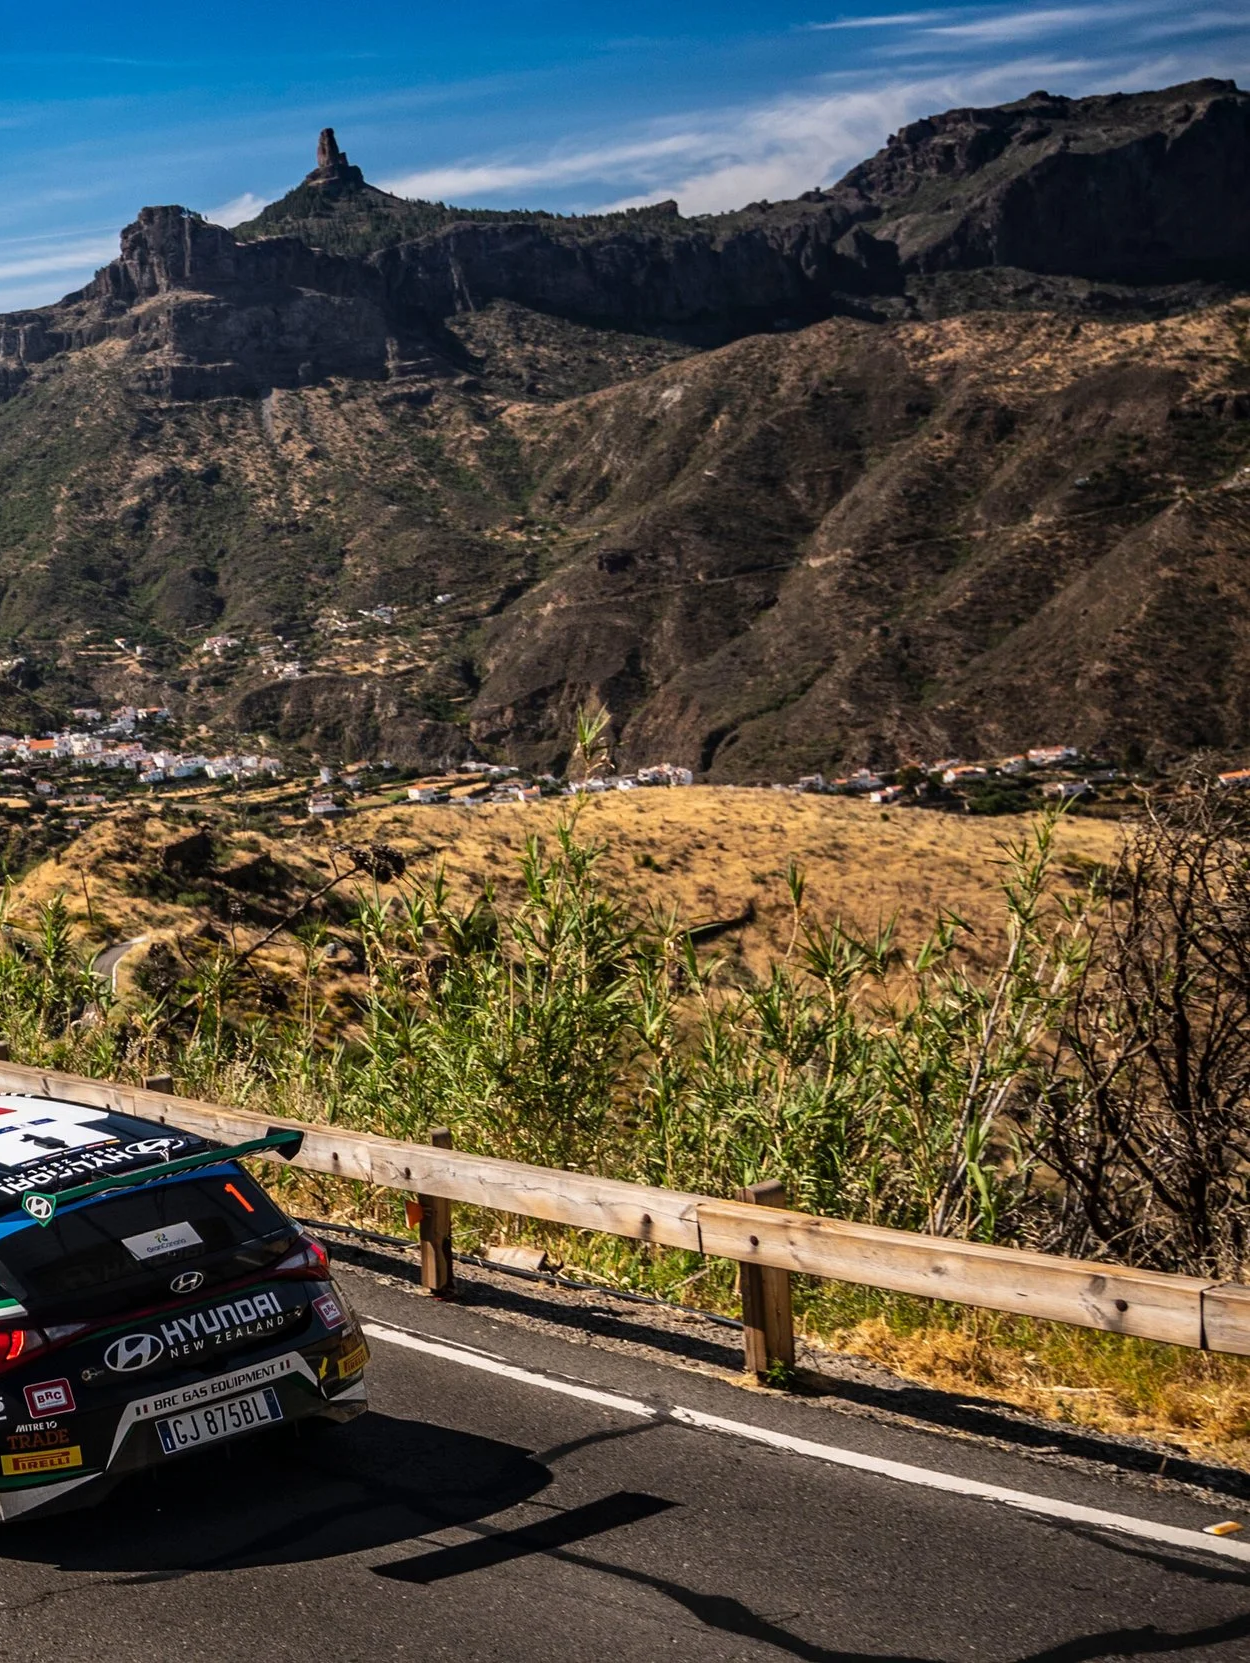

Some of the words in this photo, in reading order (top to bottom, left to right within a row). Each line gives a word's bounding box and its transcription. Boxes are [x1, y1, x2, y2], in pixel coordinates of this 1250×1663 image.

[80, 1147, 117, 1159] NEW
[224, 1182, 255, 1212] 1
[160, 1291, 283, 1346] HYUNDAI
[170, 1340, 205, 1358] NEW
[214, 1315, 284, 1344] ZEALAND
[37, 1390, 62, 1404] BRC
[154, 1394, 179, 1411] BRC
[182, 1386, 208, 1403] GAS
[211, 1364, 276, 1395] EQUIPMENT
[15, 1421, 44, 1433] MITRE
[45, 1420, 58, 1430] 10
[172, 1415, 200, 1445] GJ
[7, 1429, 70, 1450] TRADE
[12, 1451, 71, 1471] PIRELLI
